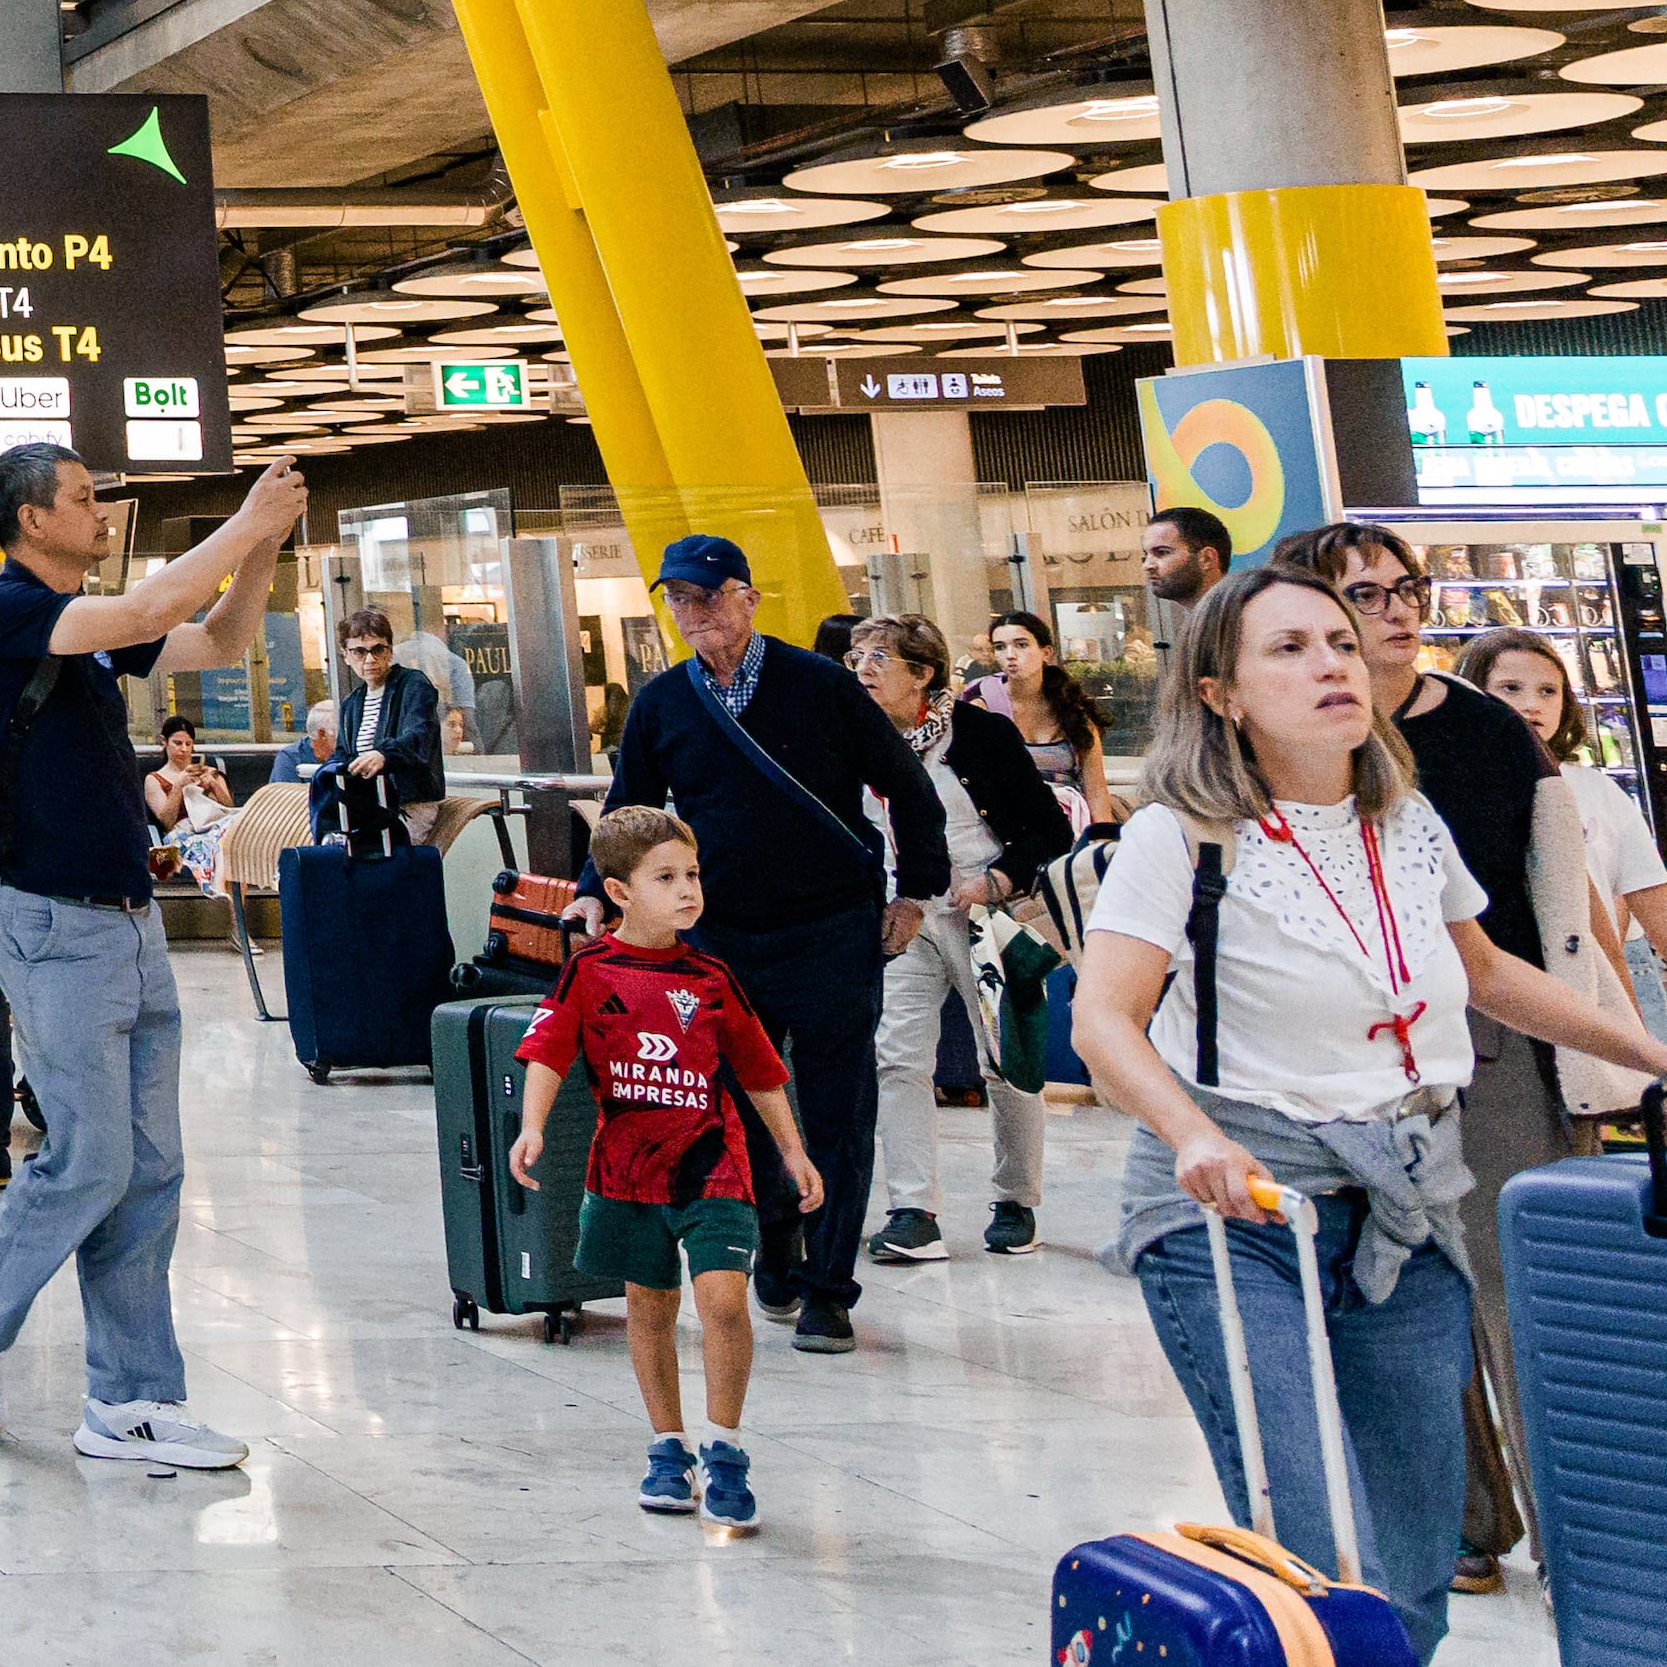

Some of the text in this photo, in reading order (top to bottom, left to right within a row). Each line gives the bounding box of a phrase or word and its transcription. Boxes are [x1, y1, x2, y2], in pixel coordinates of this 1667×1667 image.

[64, 234, 113, 271] P4
[51, 325, 102, 363] T4
[0, 387, 63, 408] Uber
[134, 382, 188, 407] Bolt
[973, 386, 1005, 397] Aseos
[1513, 393, 1651, 428] DESPEGA
[465, 647, 512, 674] PAUL
[610, 1060, 708, 1089] MIRANDA
[612, 1081, 708, 1110] EMPRESAS
